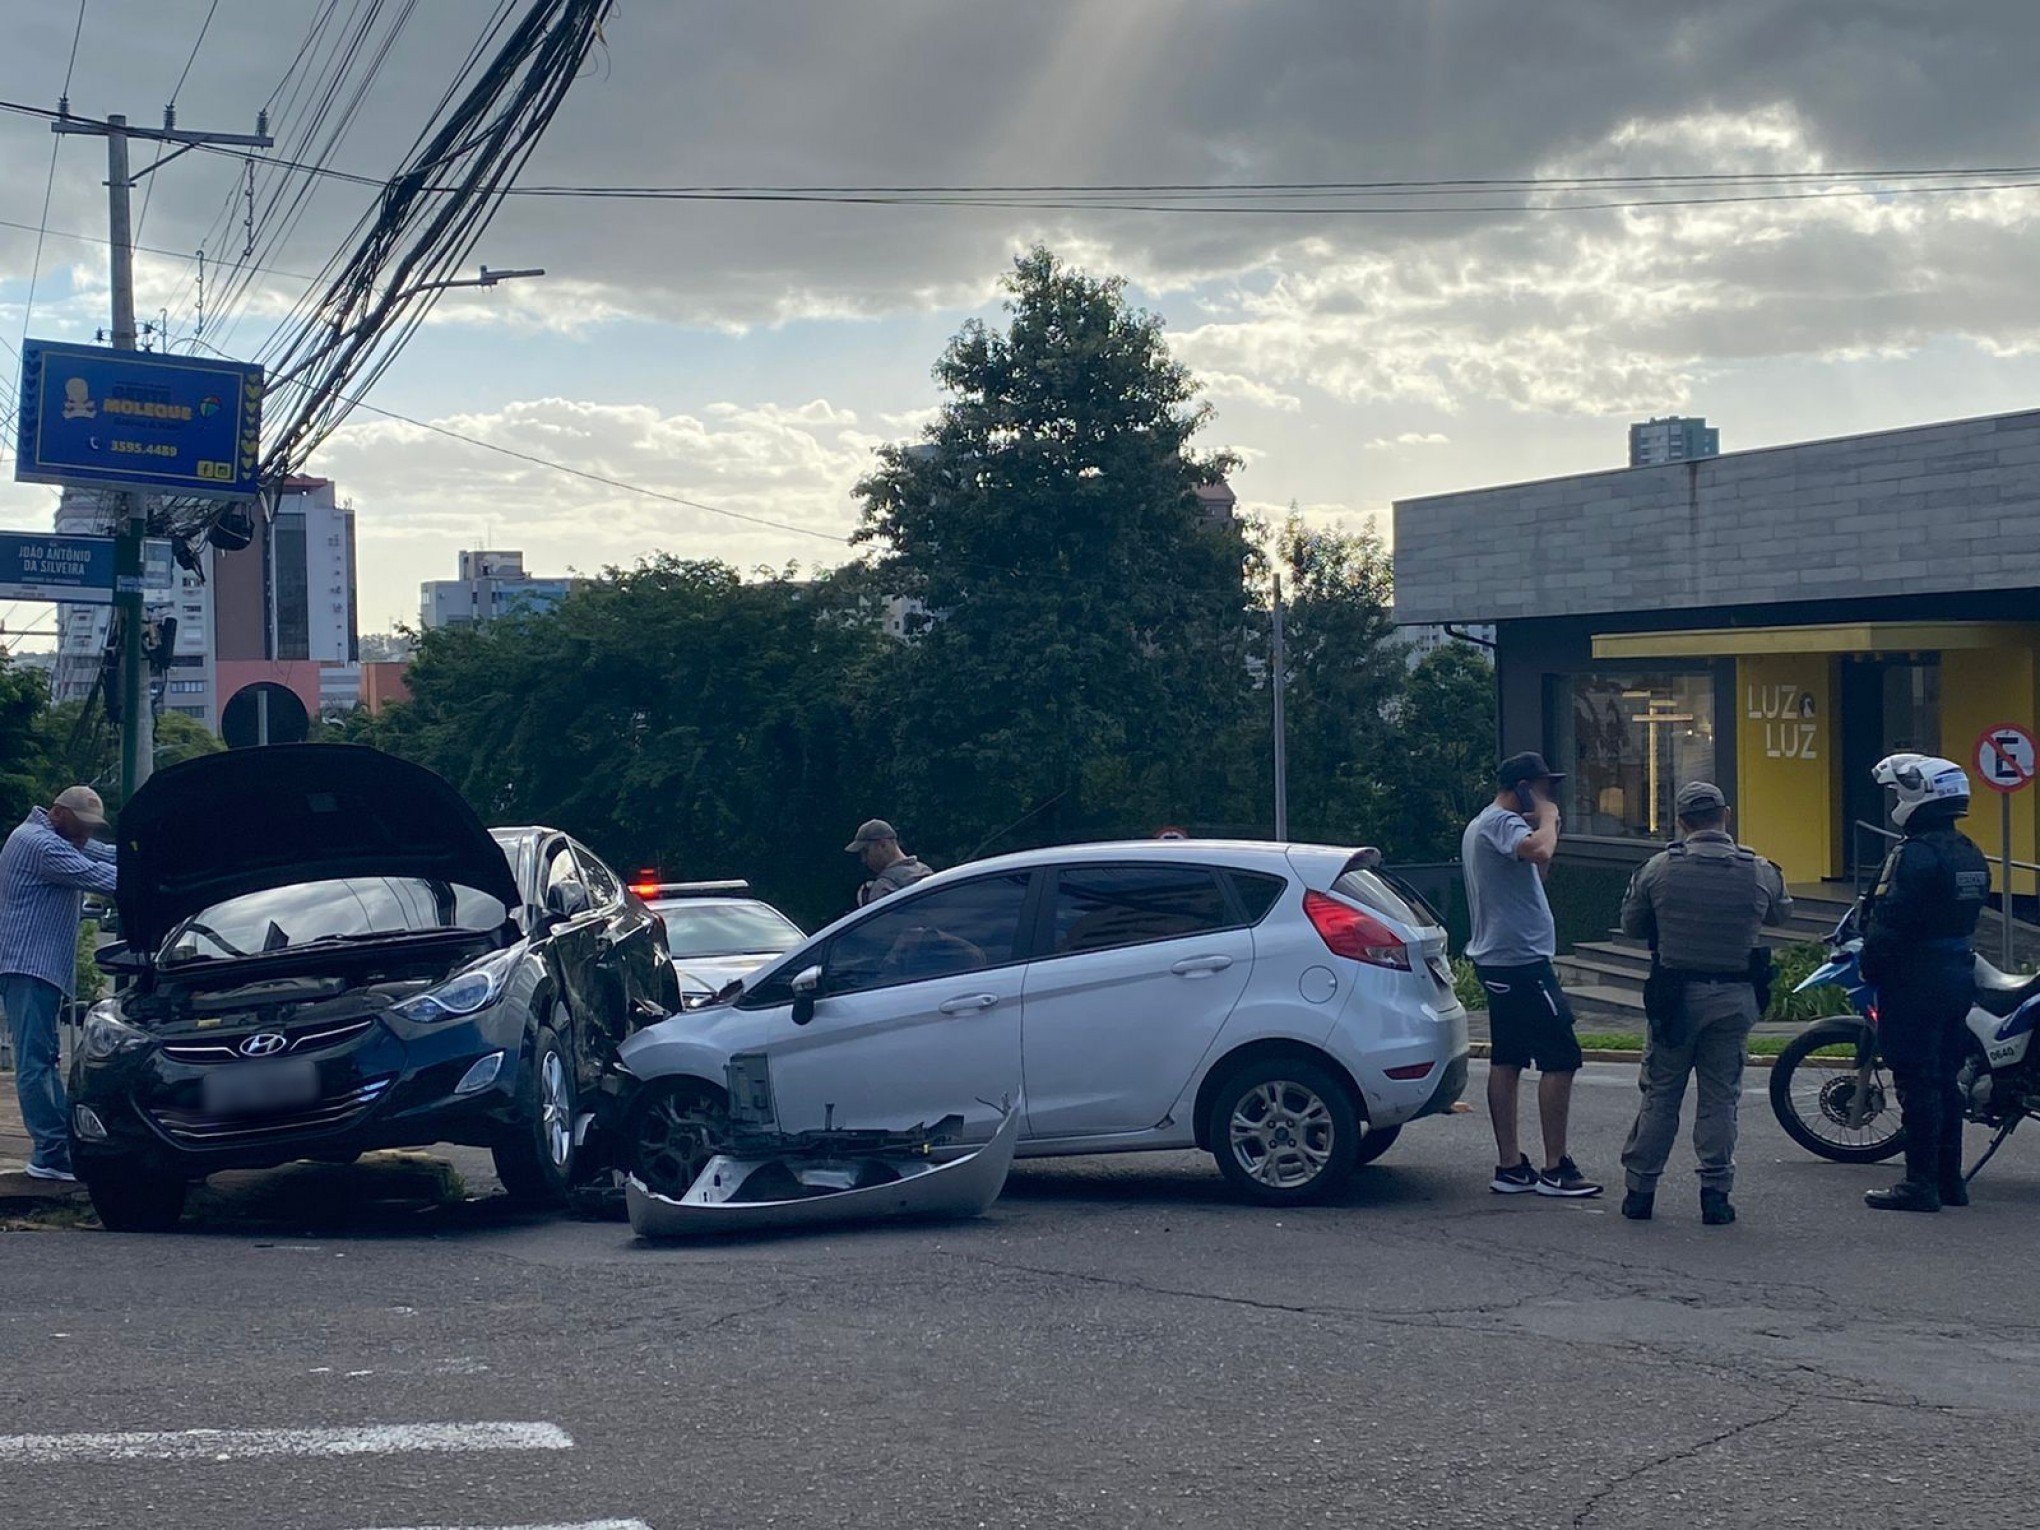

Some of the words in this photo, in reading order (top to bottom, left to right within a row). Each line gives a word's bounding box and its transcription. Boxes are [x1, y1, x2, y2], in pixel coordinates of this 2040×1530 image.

[103, 398, 192, 421] MOLEQUE
[23, 560, 37, 571] DA
[40, 560, 85, 576] SILVEIRA
[1748, 684, 1798, 719] LUZ
[1766, 723, 1817, 759] LUZ
